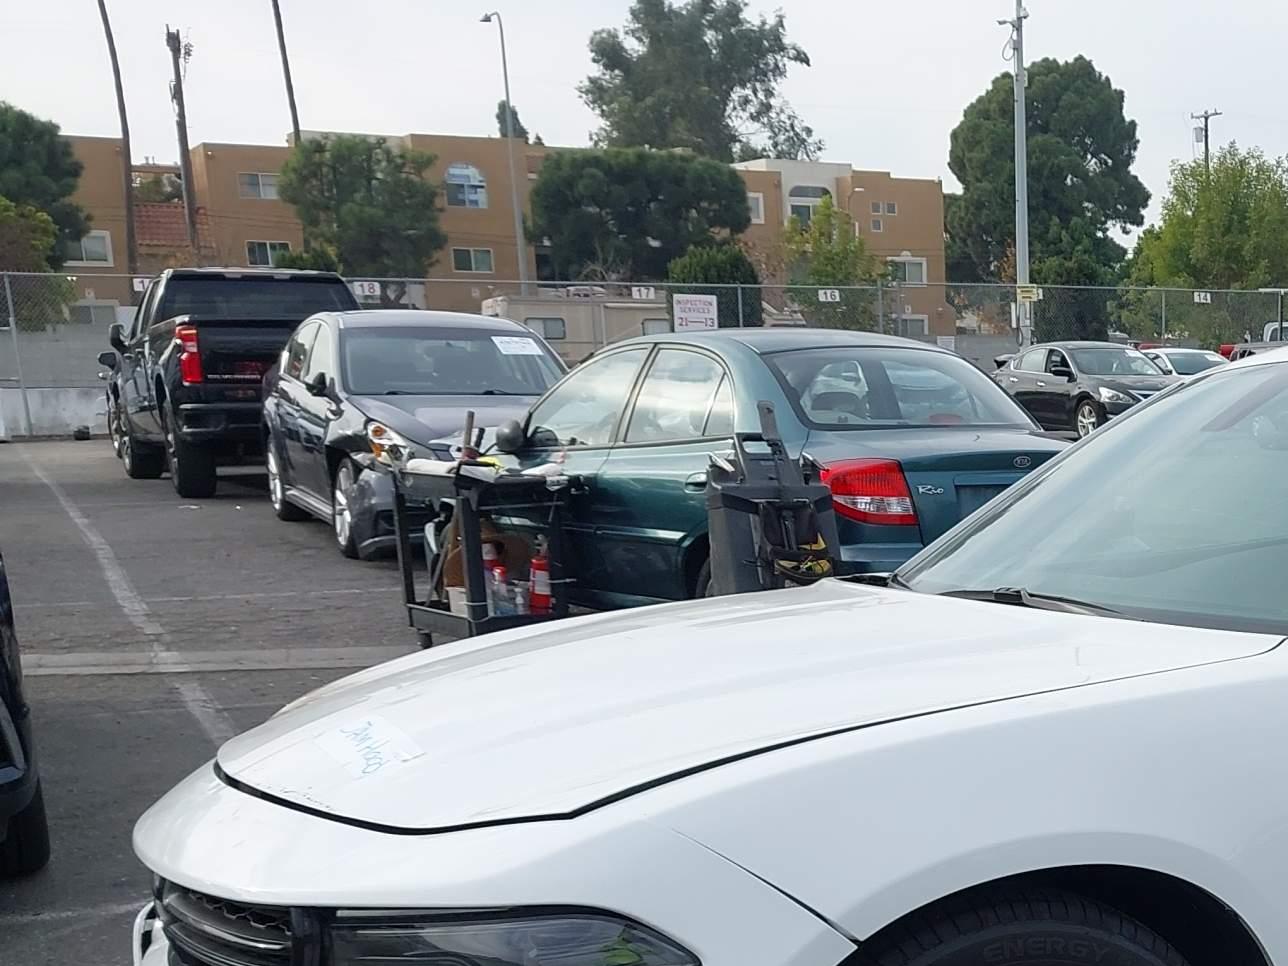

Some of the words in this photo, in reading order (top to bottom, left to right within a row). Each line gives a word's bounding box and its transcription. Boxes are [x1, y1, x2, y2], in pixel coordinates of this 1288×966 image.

[358, 282, 376, 294] 18
[636, 287, 651, 298] 17
[823, 290, 837, 301] 16
[675, 299, 714, 307] INSPECTION
[679, 306, 711, 314] SERVICES
[916, 485, 944, 495] Rio
[983, 935, 1112, 963] ENERGY
